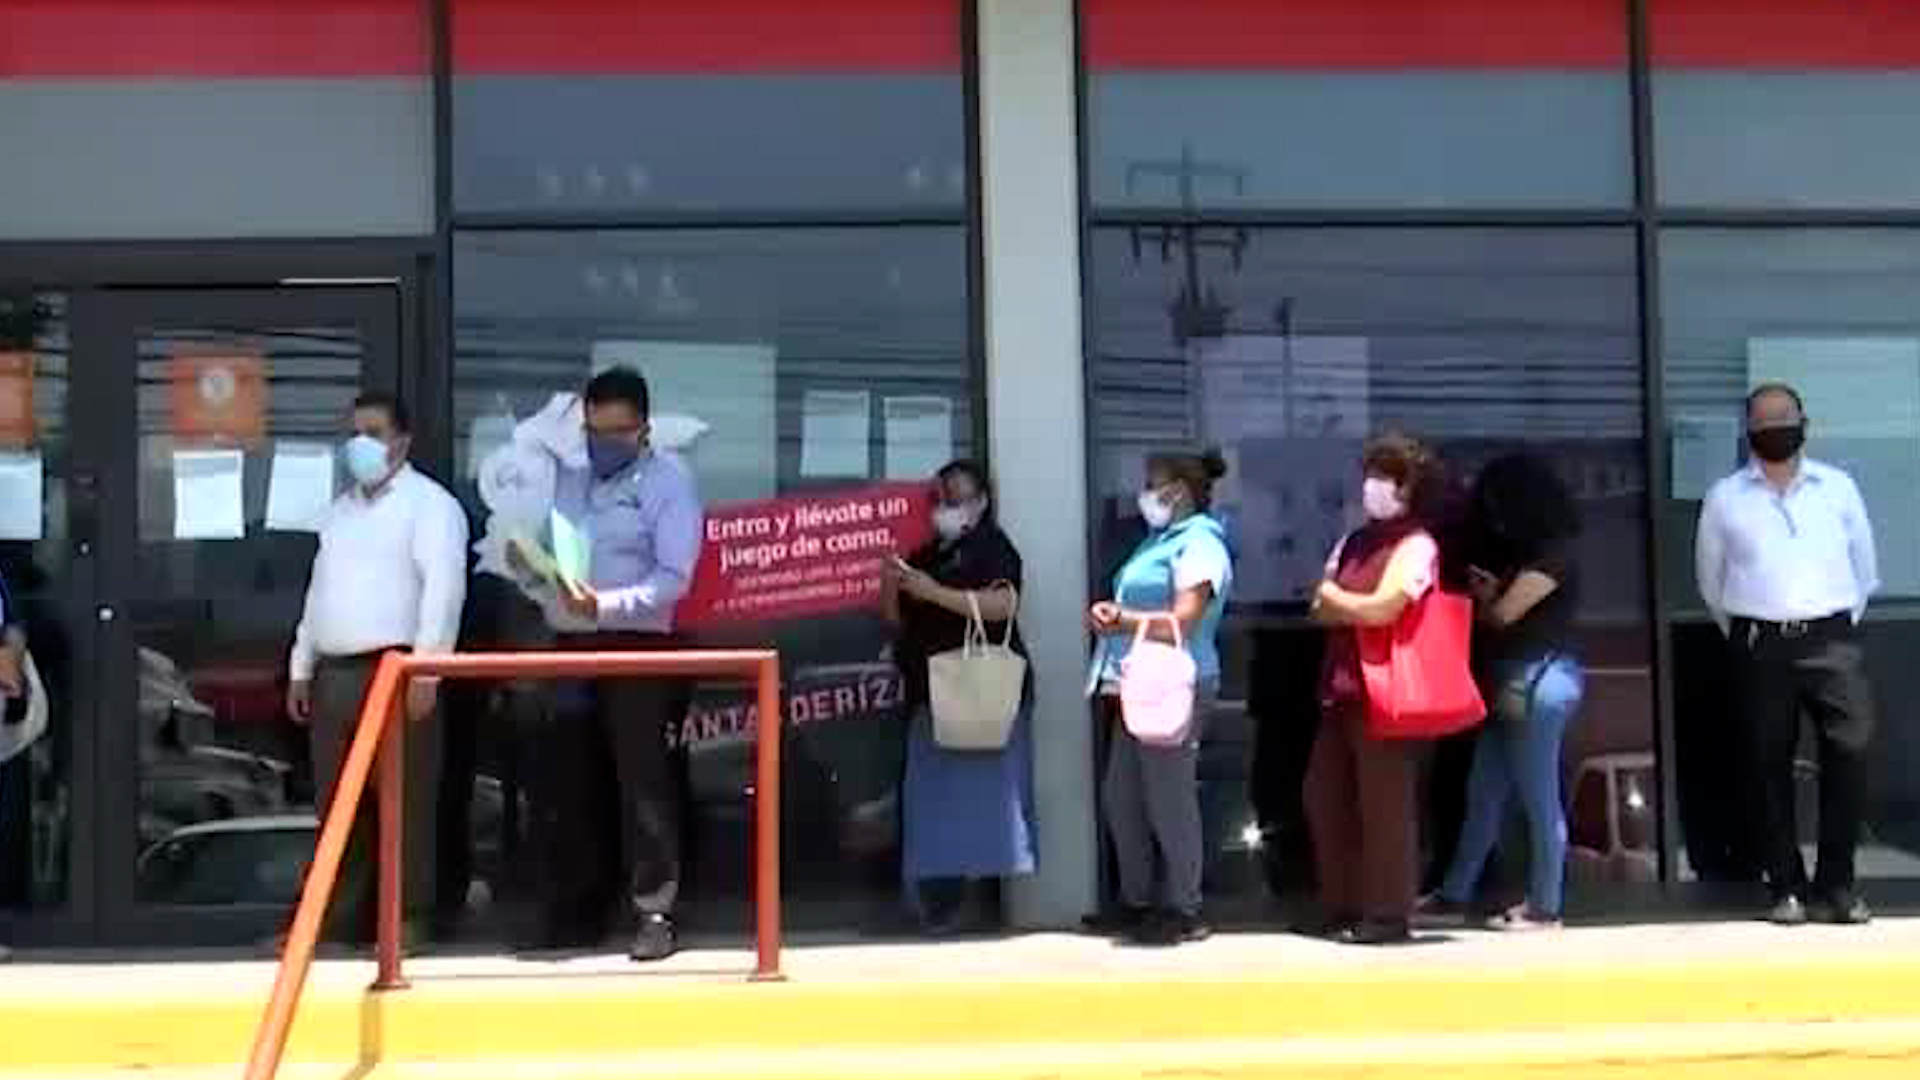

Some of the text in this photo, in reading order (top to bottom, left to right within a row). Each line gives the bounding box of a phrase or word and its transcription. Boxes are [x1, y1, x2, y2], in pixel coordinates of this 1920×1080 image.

[706, 497, 909, 540] Entra y llévate un
[719, 541, 786, 574] juego
[790, 533, 821, 558] de
[825, 526, 897, 552] cama,
